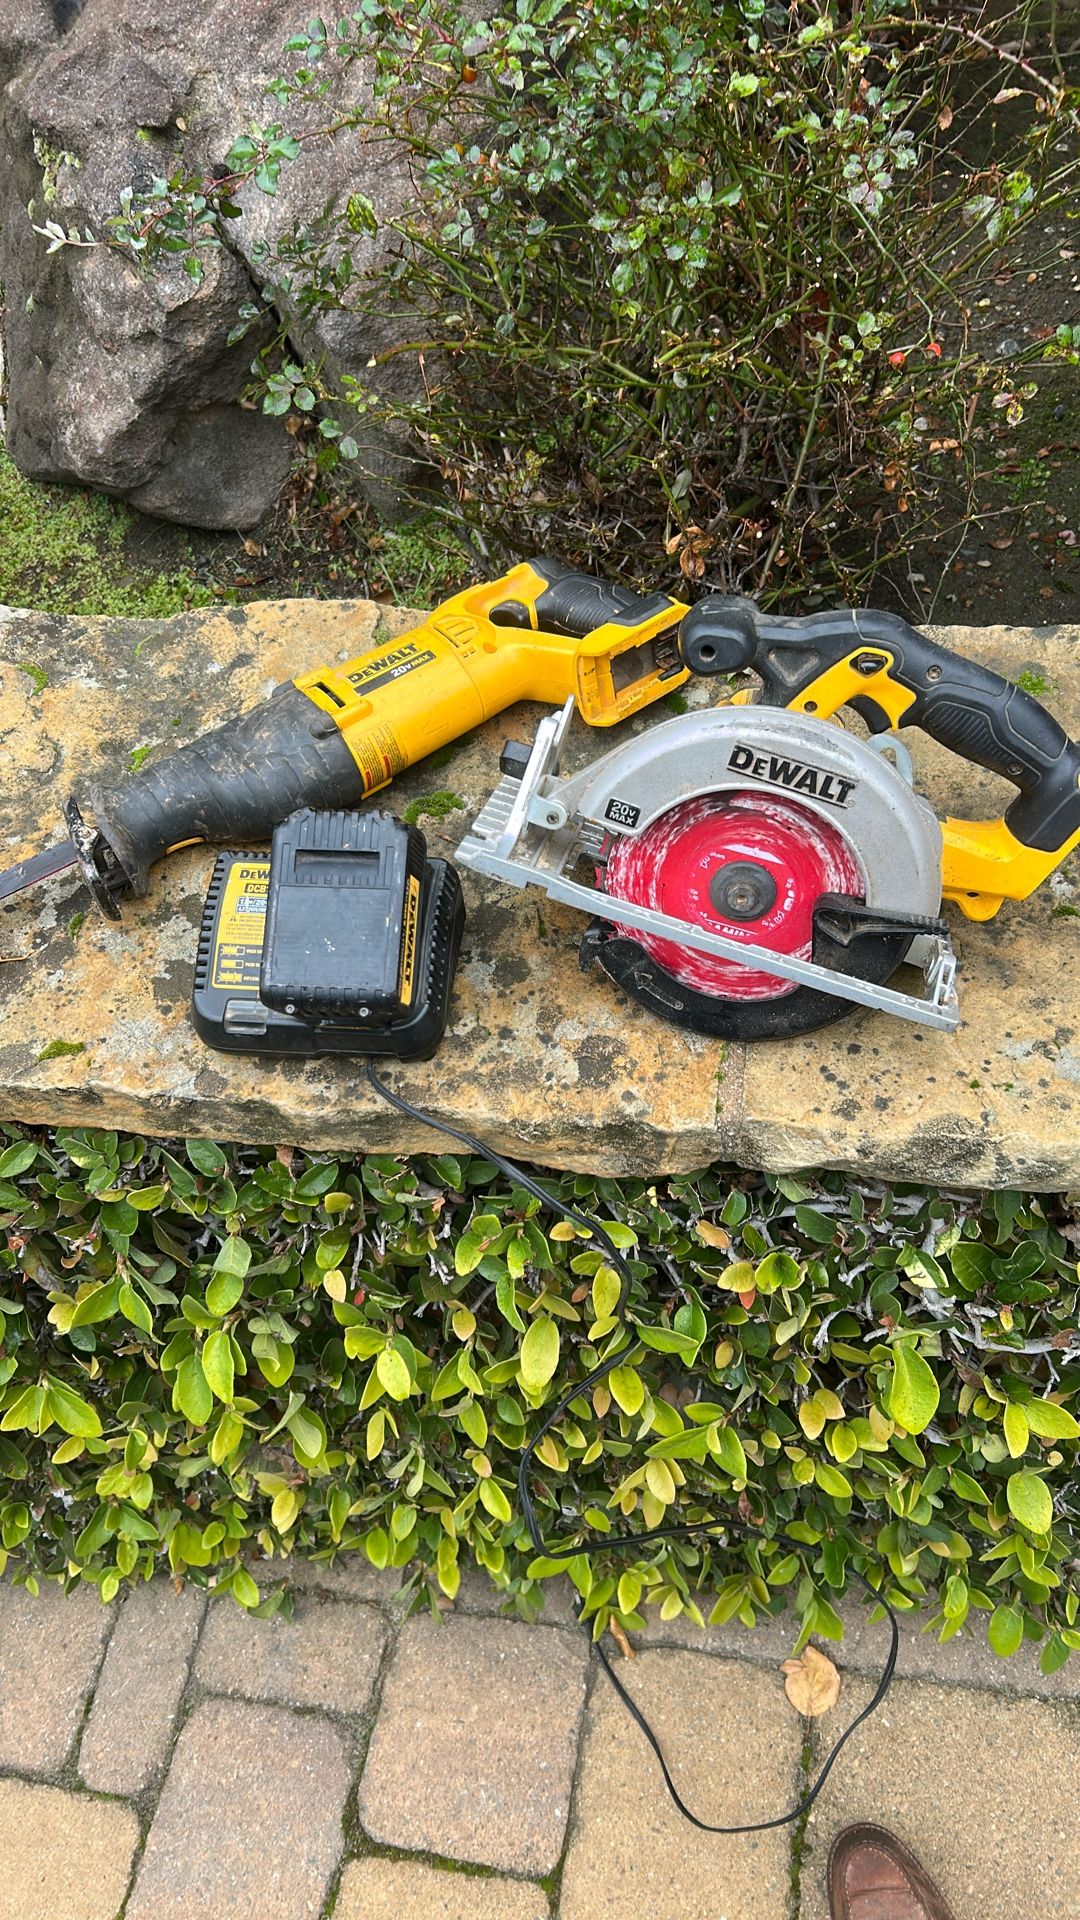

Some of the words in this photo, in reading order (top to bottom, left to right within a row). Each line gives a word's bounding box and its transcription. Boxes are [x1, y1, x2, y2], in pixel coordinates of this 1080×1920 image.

[347, 643, 418, 683] DEWALT
[411, 654, 430, 667] MAX
[728, 744, 856, 803] DEWALT
[609, 811, 634, 825] MAX
[240, 869, 269, 879] DEW
[404, 894, 417, 986] DEWALT
